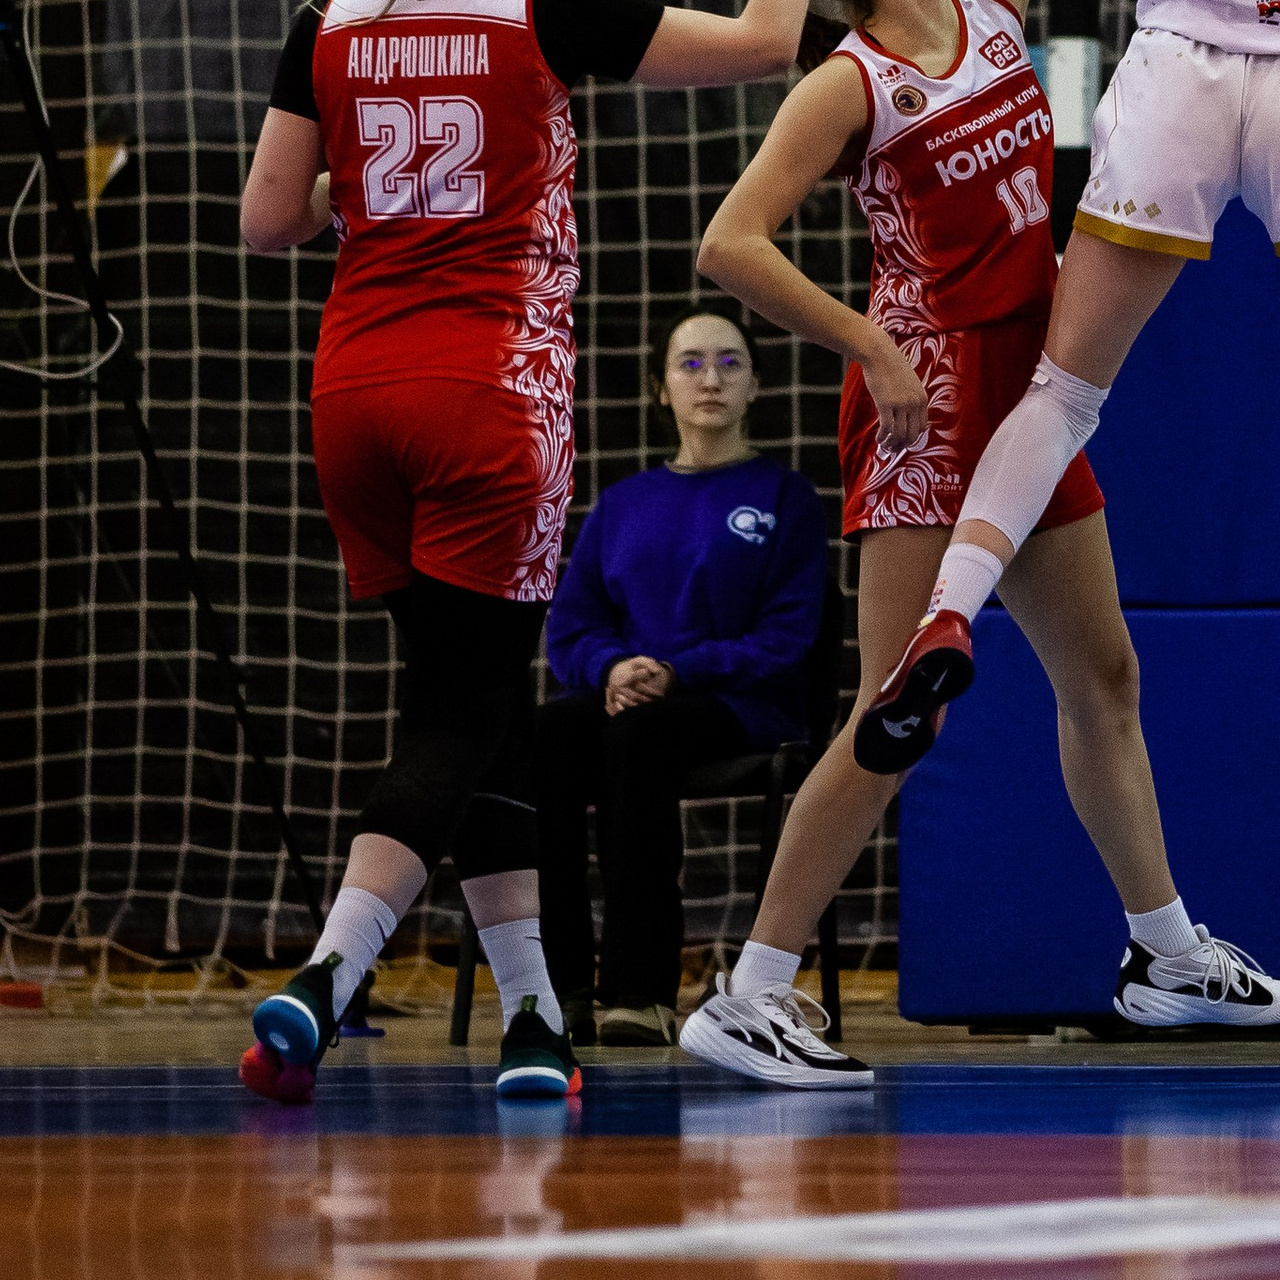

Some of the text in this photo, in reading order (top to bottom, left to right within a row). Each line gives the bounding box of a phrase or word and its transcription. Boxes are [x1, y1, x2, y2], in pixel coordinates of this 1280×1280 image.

[346, 33, 490, 85] АНДРЮШКИНА
[984, 32, 1008, 59] FON
[994, 43, 1018, 68] BET
[1014, 84, 1040, 107] КЛУБ
[355, 94, 486, 222] 22
[934, 108, 1051, 188] ЮНОСТЬ
[995, 165, 1049, 236] 10
